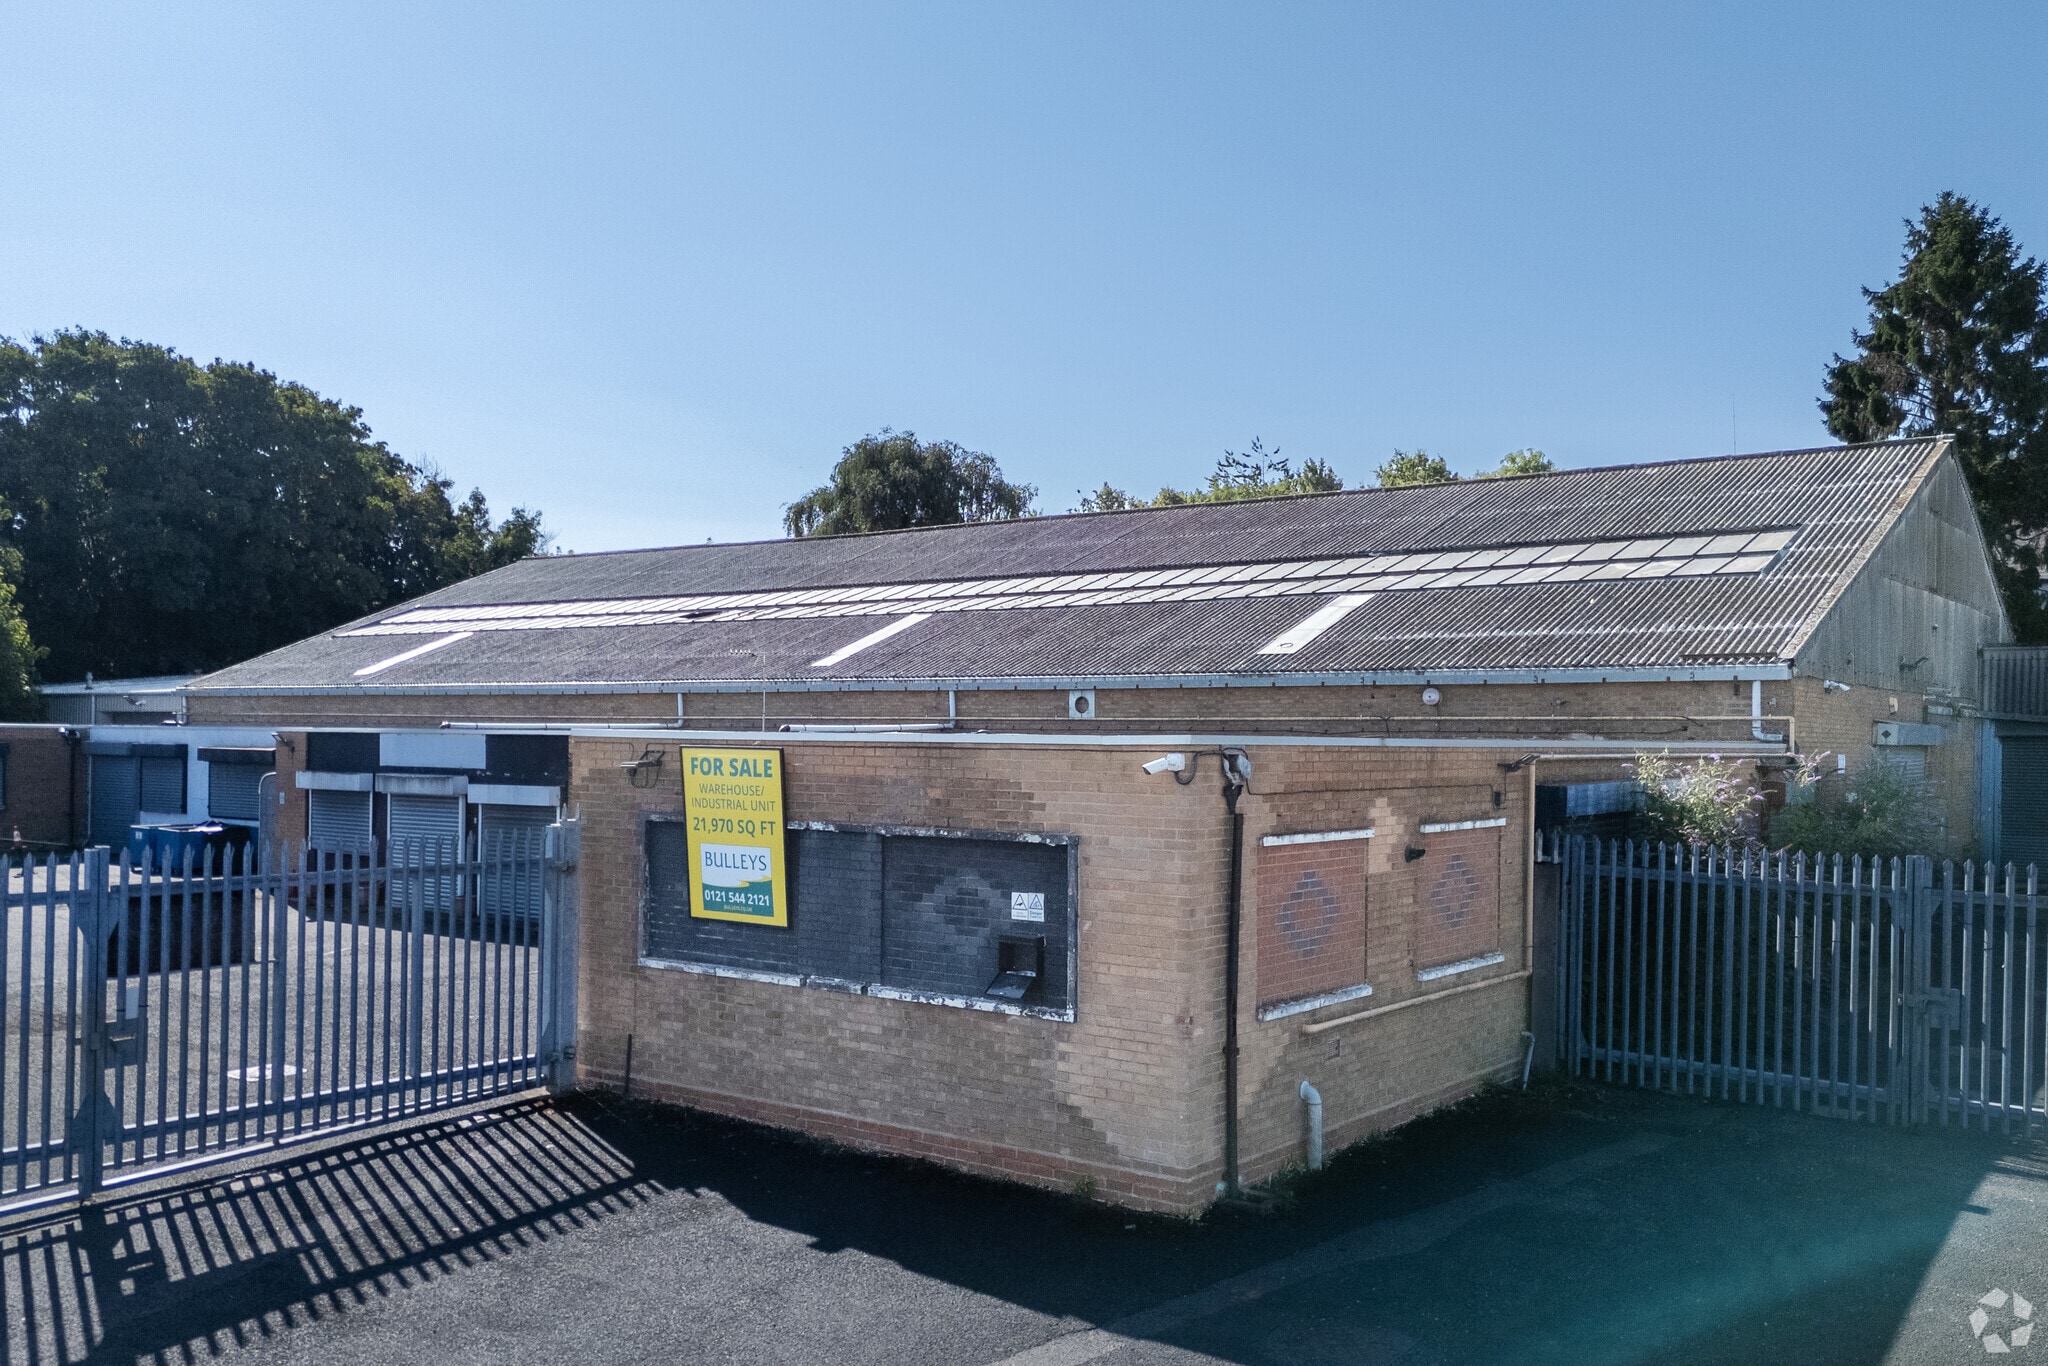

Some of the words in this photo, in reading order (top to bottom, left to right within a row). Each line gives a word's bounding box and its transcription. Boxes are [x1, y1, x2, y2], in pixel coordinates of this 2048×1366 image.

[690, 757, 724, 776] FOR
[729, 758, 773, 778] SALE
[699, 783, 765, 796] WAREHOUSE/
[691, 797, 748, 811] INDUSTRIAL
[750, 800, 776, 812] UNIT
[693, 816, 734, 834] 21,970
[737, 819, 756, 838] SQ
[760, 820, 776, 836] FT
[704, 851, 767, 871] BULLEYS
[704, 889, 726, 902] 0121
[728, 891, 746, 904] 544
[747, 893, 770, 906] 2121
